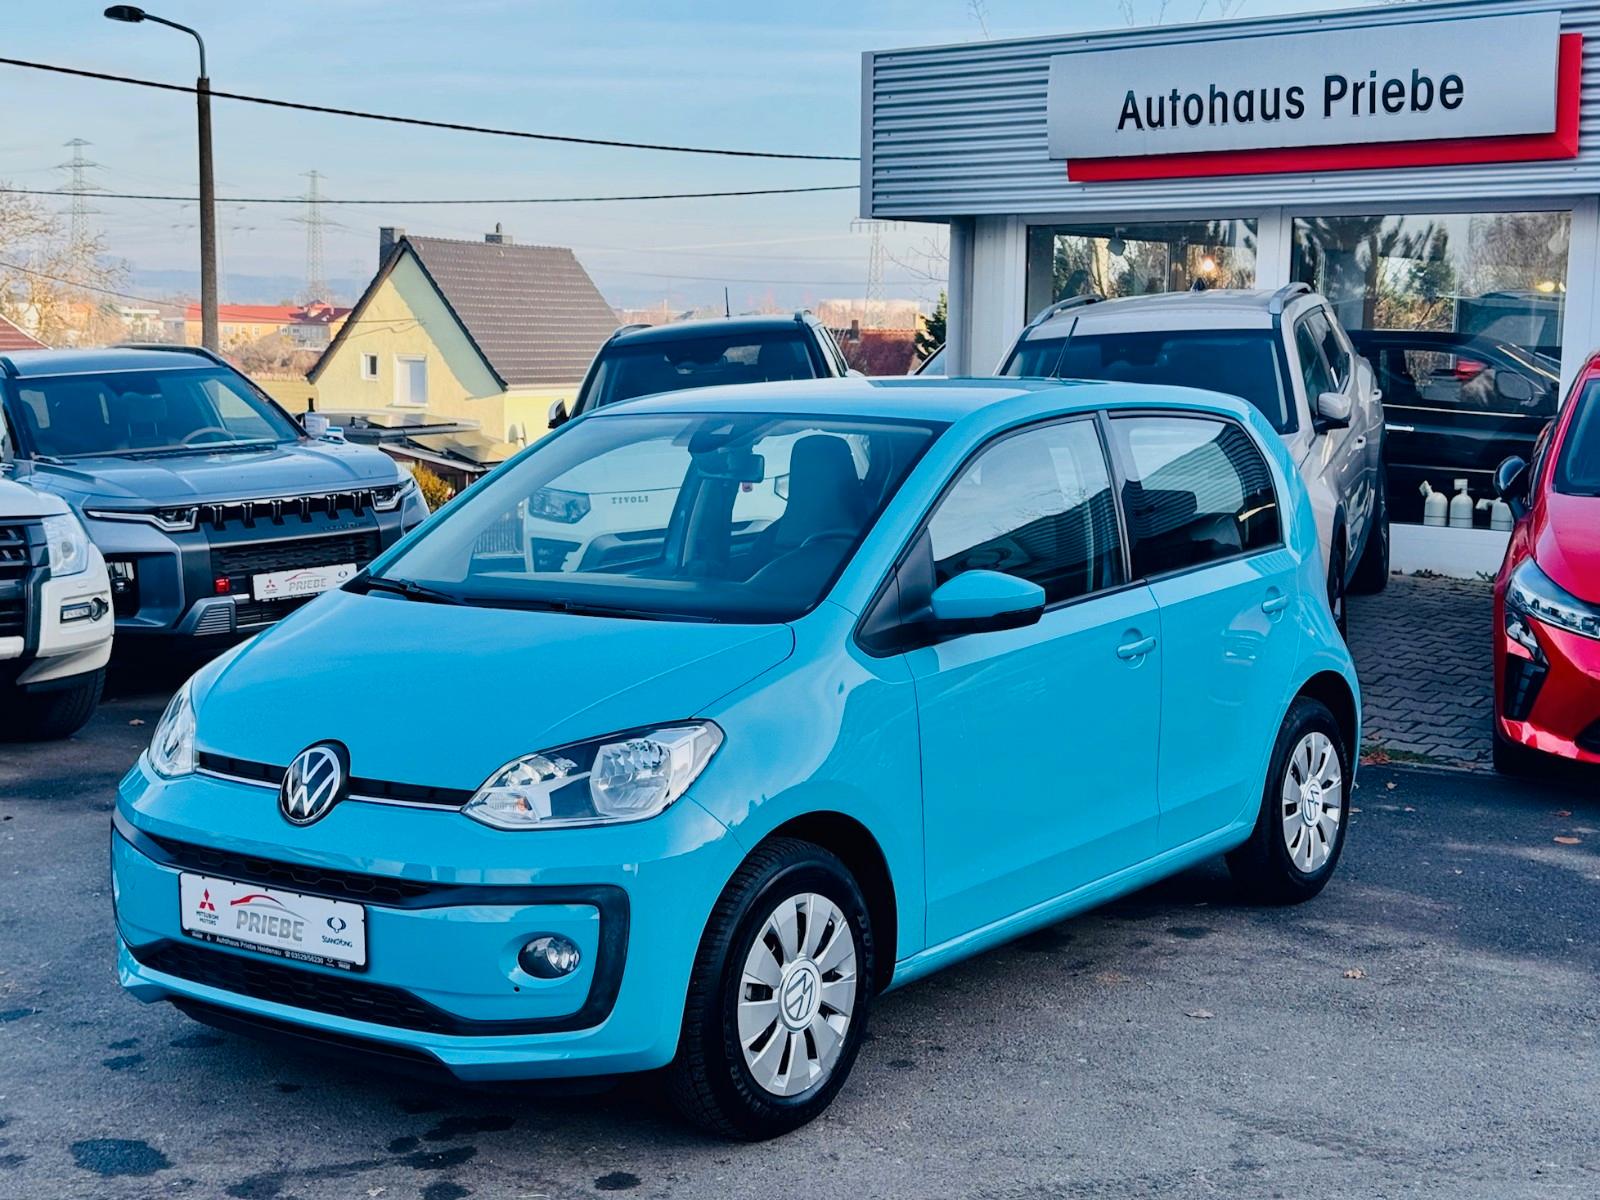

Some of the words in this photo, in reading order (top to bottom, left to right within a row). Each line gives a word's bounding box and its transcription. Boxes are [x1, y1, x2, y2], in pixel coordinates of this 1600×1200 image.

[1117, 83, 1305, 130] Autohaus
[1323, 69, 1464, 118] Priebe
[611, 495, 649, 505] TIVOLI
[288, 578, 327, 592] PRIEBE
[236, 909, 305, 942] PRIEBE
[216, 936, 240, 948] Autohaus
[240, 941, 257, 952] Priebe
